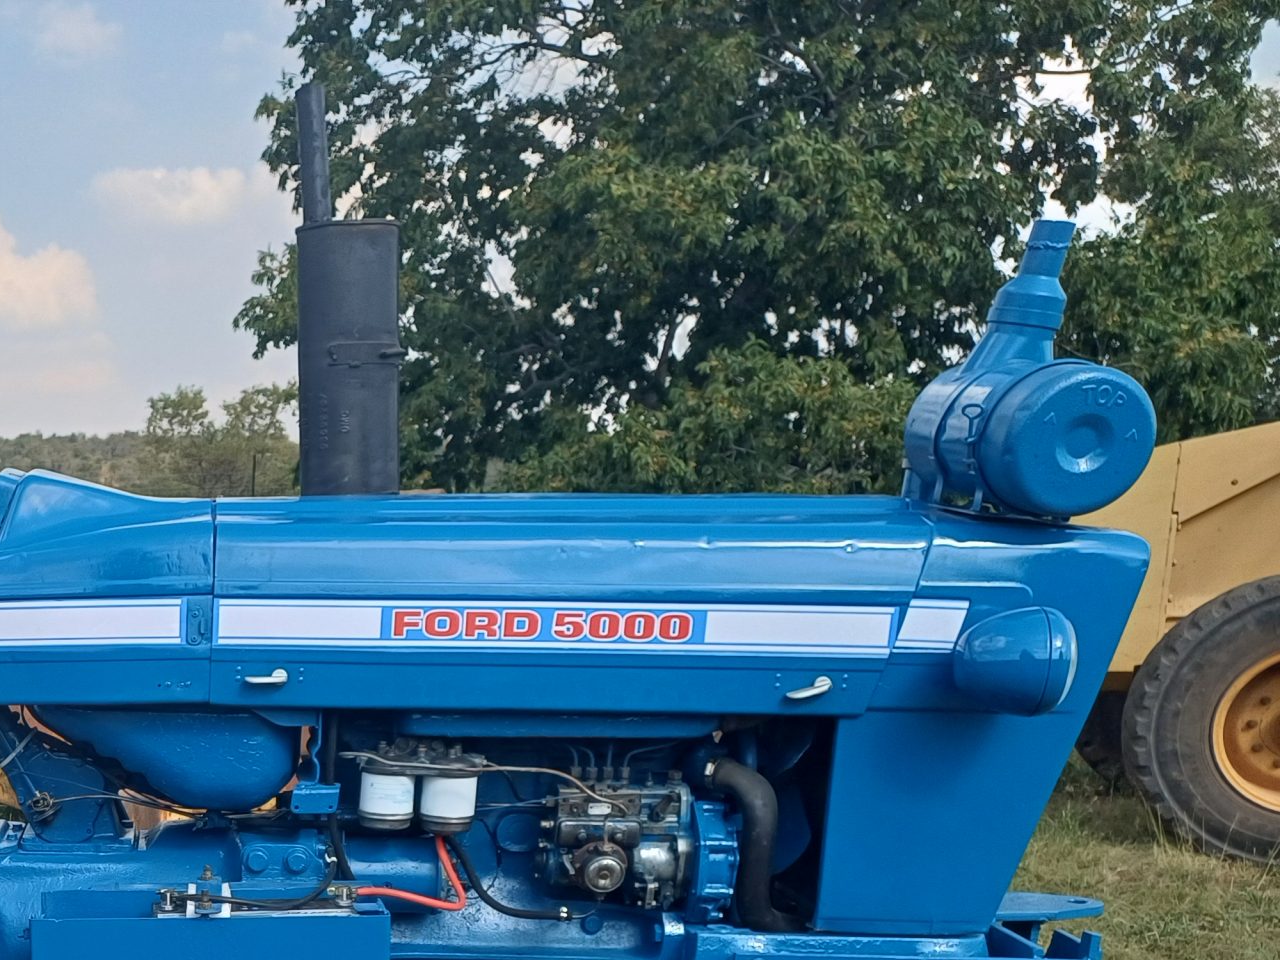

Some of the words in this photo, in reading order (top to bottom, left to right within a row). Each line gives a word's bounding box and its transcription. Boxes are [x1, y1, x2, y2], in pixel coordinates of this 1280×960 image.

[1081, 384, 1128, 408] TOP
[392, 608, 542, 639] FORD
[552, 611, 693, 642] 5000
